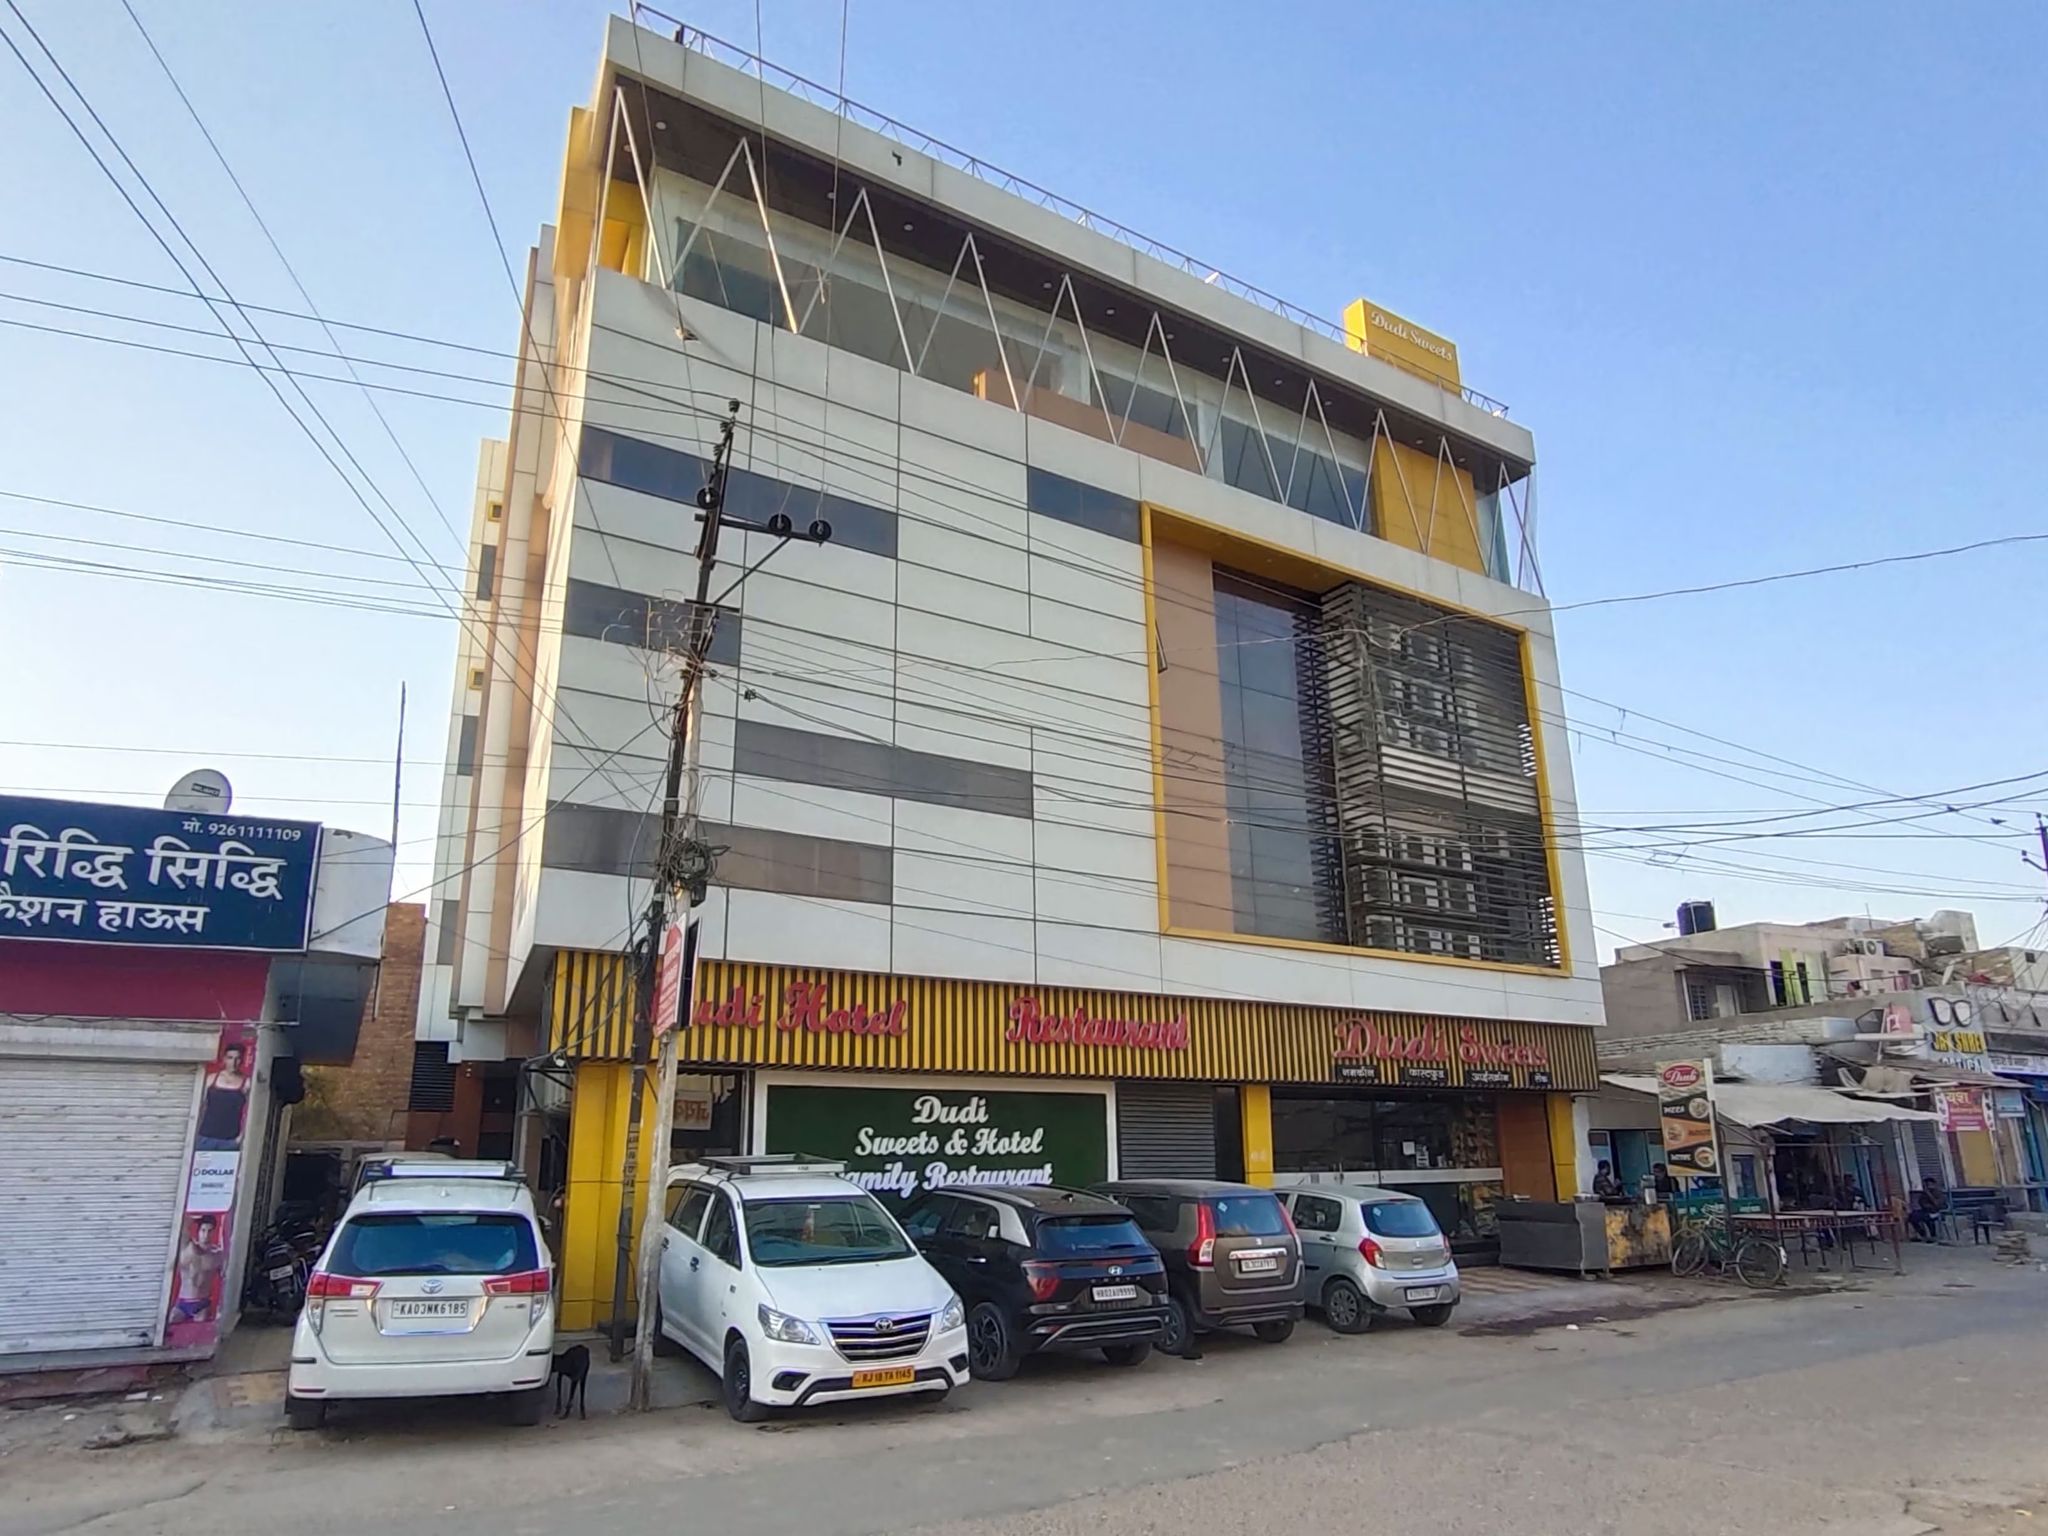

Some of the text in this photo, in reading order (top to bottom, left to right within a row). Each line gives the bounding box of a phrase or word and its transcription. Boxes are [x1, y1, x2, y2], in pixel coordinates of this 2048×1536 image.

[1370, 310, 1453, 361] Dudi Sweets
[182, 817, 301, 841] मो. 9261111109
[0, 824, 289, 901] रिद्धि सिद्धि
[96, 900, 211, 933] हाऊस
[777, 981, 908, 1037] Hotel
[1006, 996, 1190, 1050] Restaurant
[1333, 1016, 1548, 1066] Dudi Sweets
[911, 1095, 989, 1124] Dudi
[855, 1127, 1044, 1156] Sweets & Hotel
[838, 1161, 1053, 1199] amily Restaurant
